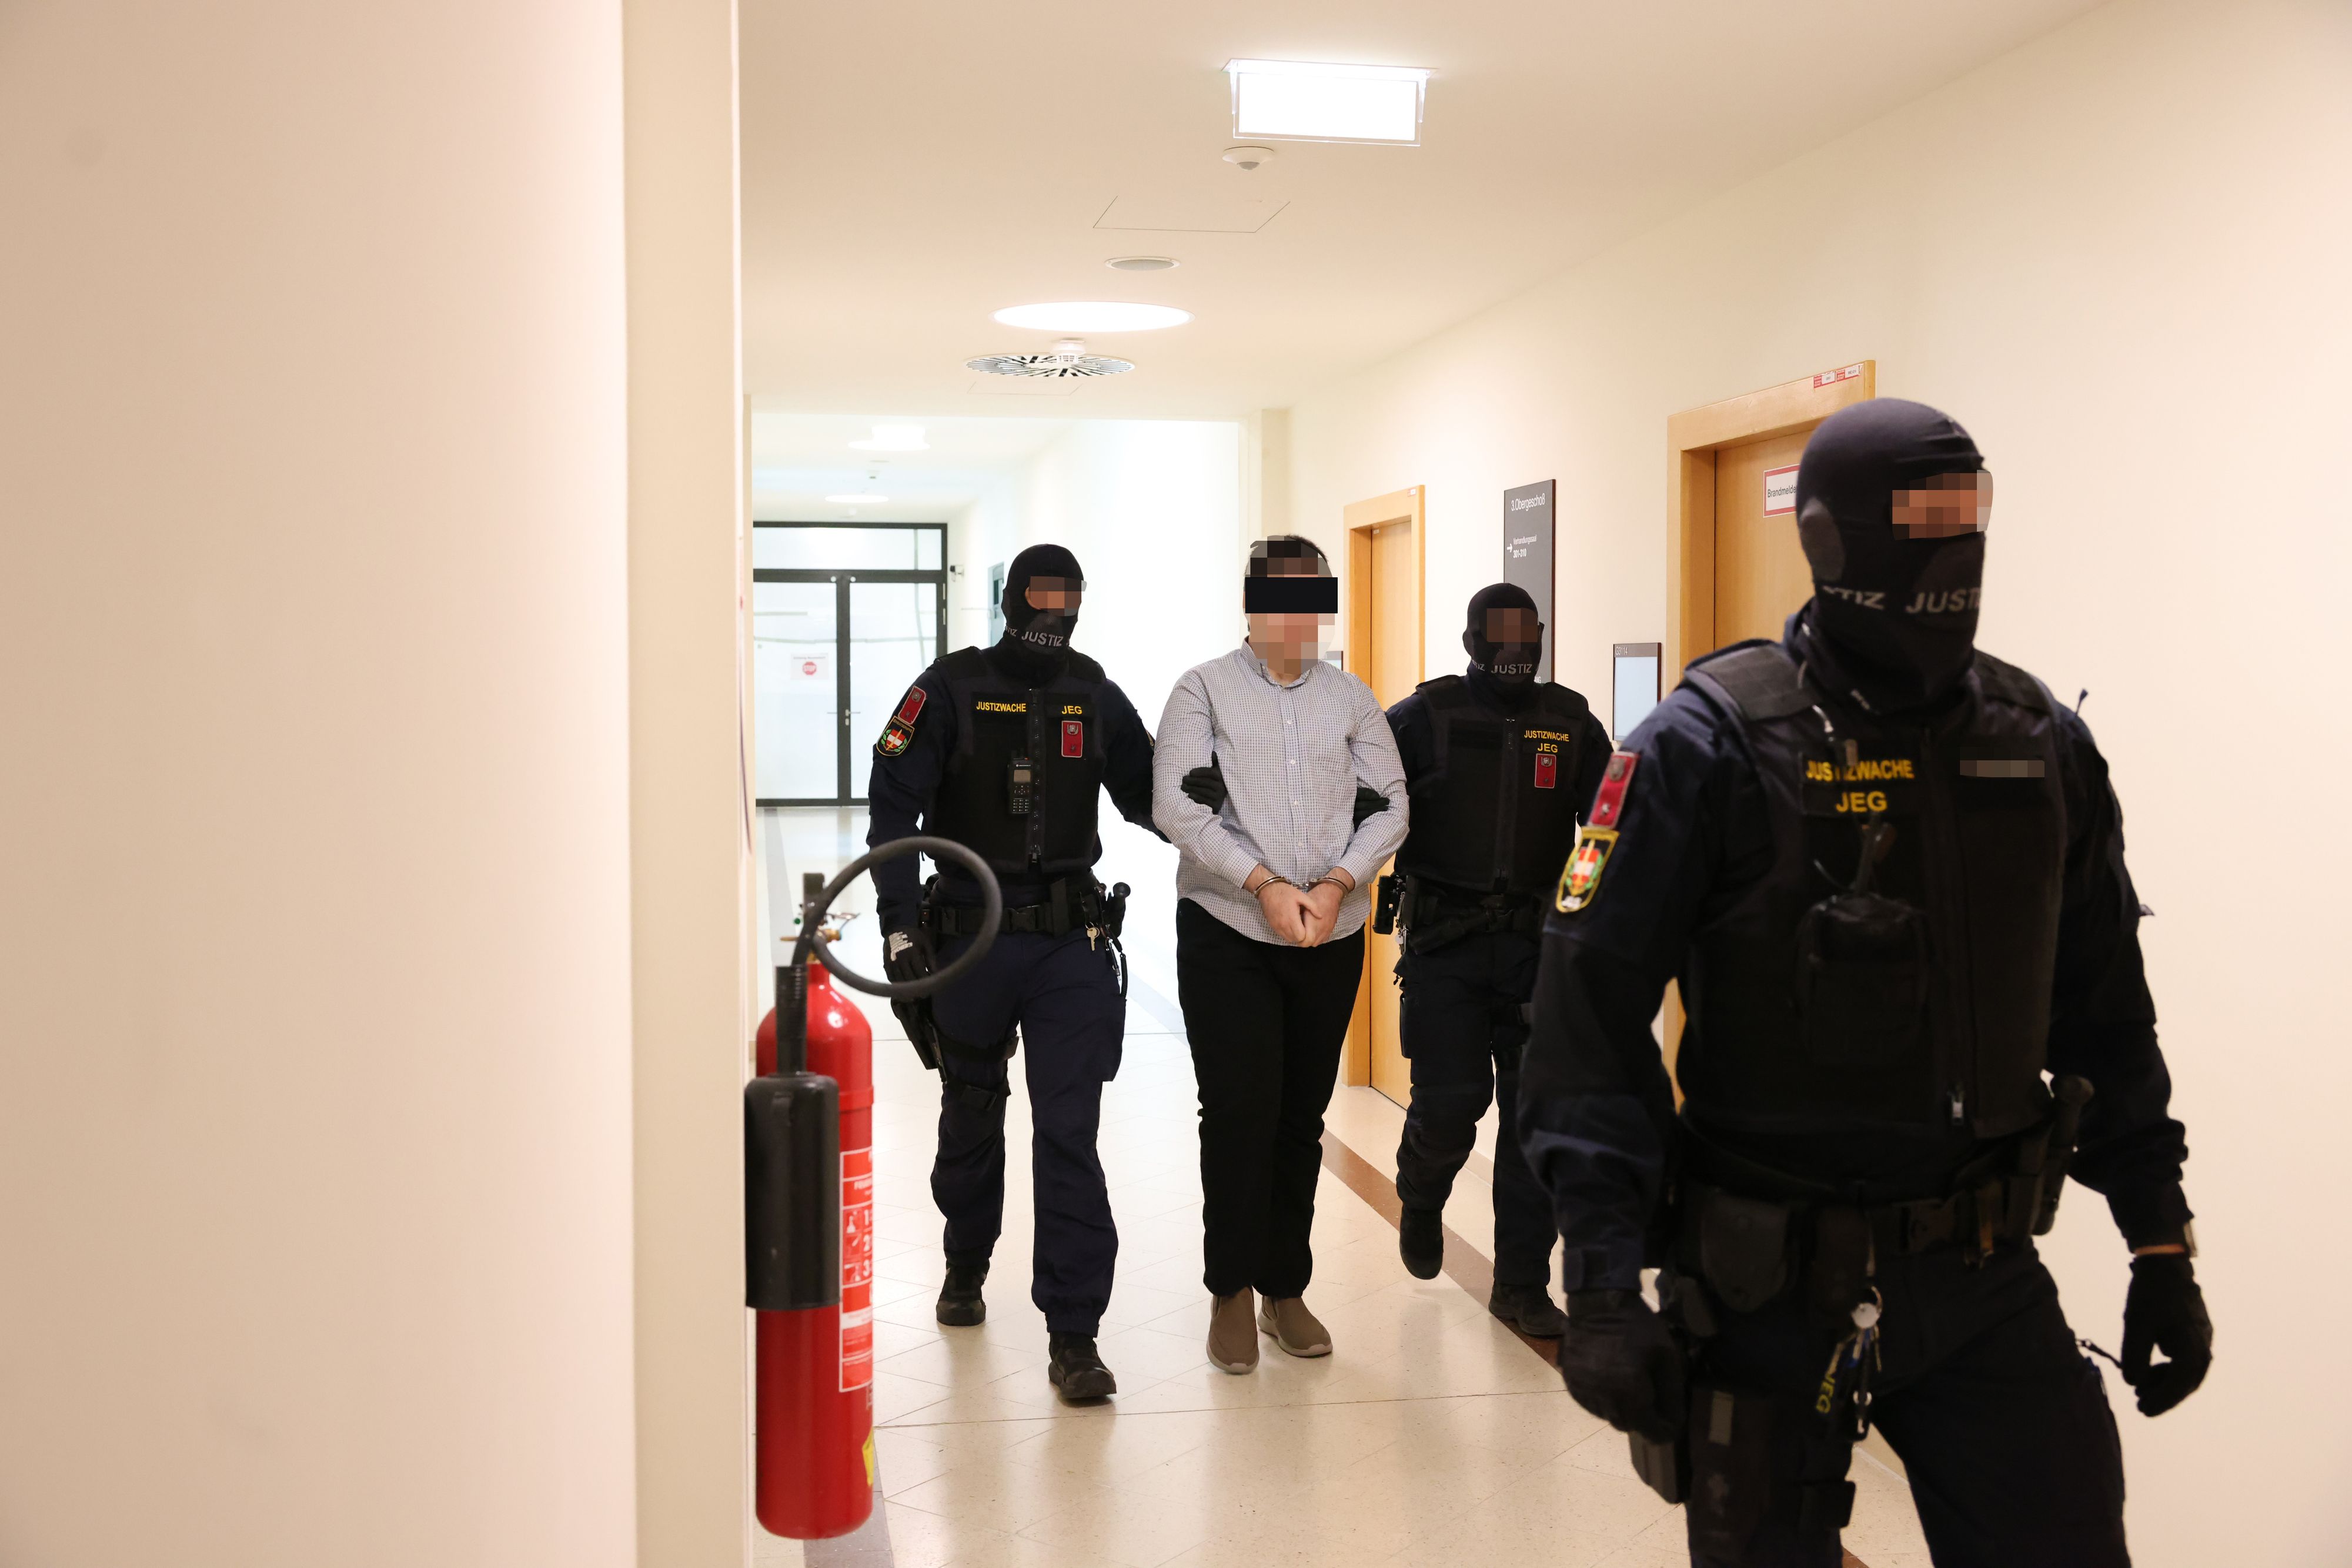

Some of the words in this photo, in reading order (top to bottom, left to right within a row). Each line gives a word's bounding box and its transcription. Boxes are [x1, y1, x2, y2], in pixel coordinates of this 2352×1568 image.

[1513, 549, 1527, 559] 301-310
[1021, 631, 1063, 647] JUSTIZ
[1491, 664, 1532, 675] JUSTIZ
[977, 701, 1027, 712] JUSTIZWACHE
[1061, 706, 1083, 714] JEG
[1524, 730, 1569, 742] JUSTIZWACHE
[1537, 743, 1558, 753] JEG
[1835, 790, 1888, 813] JEG
